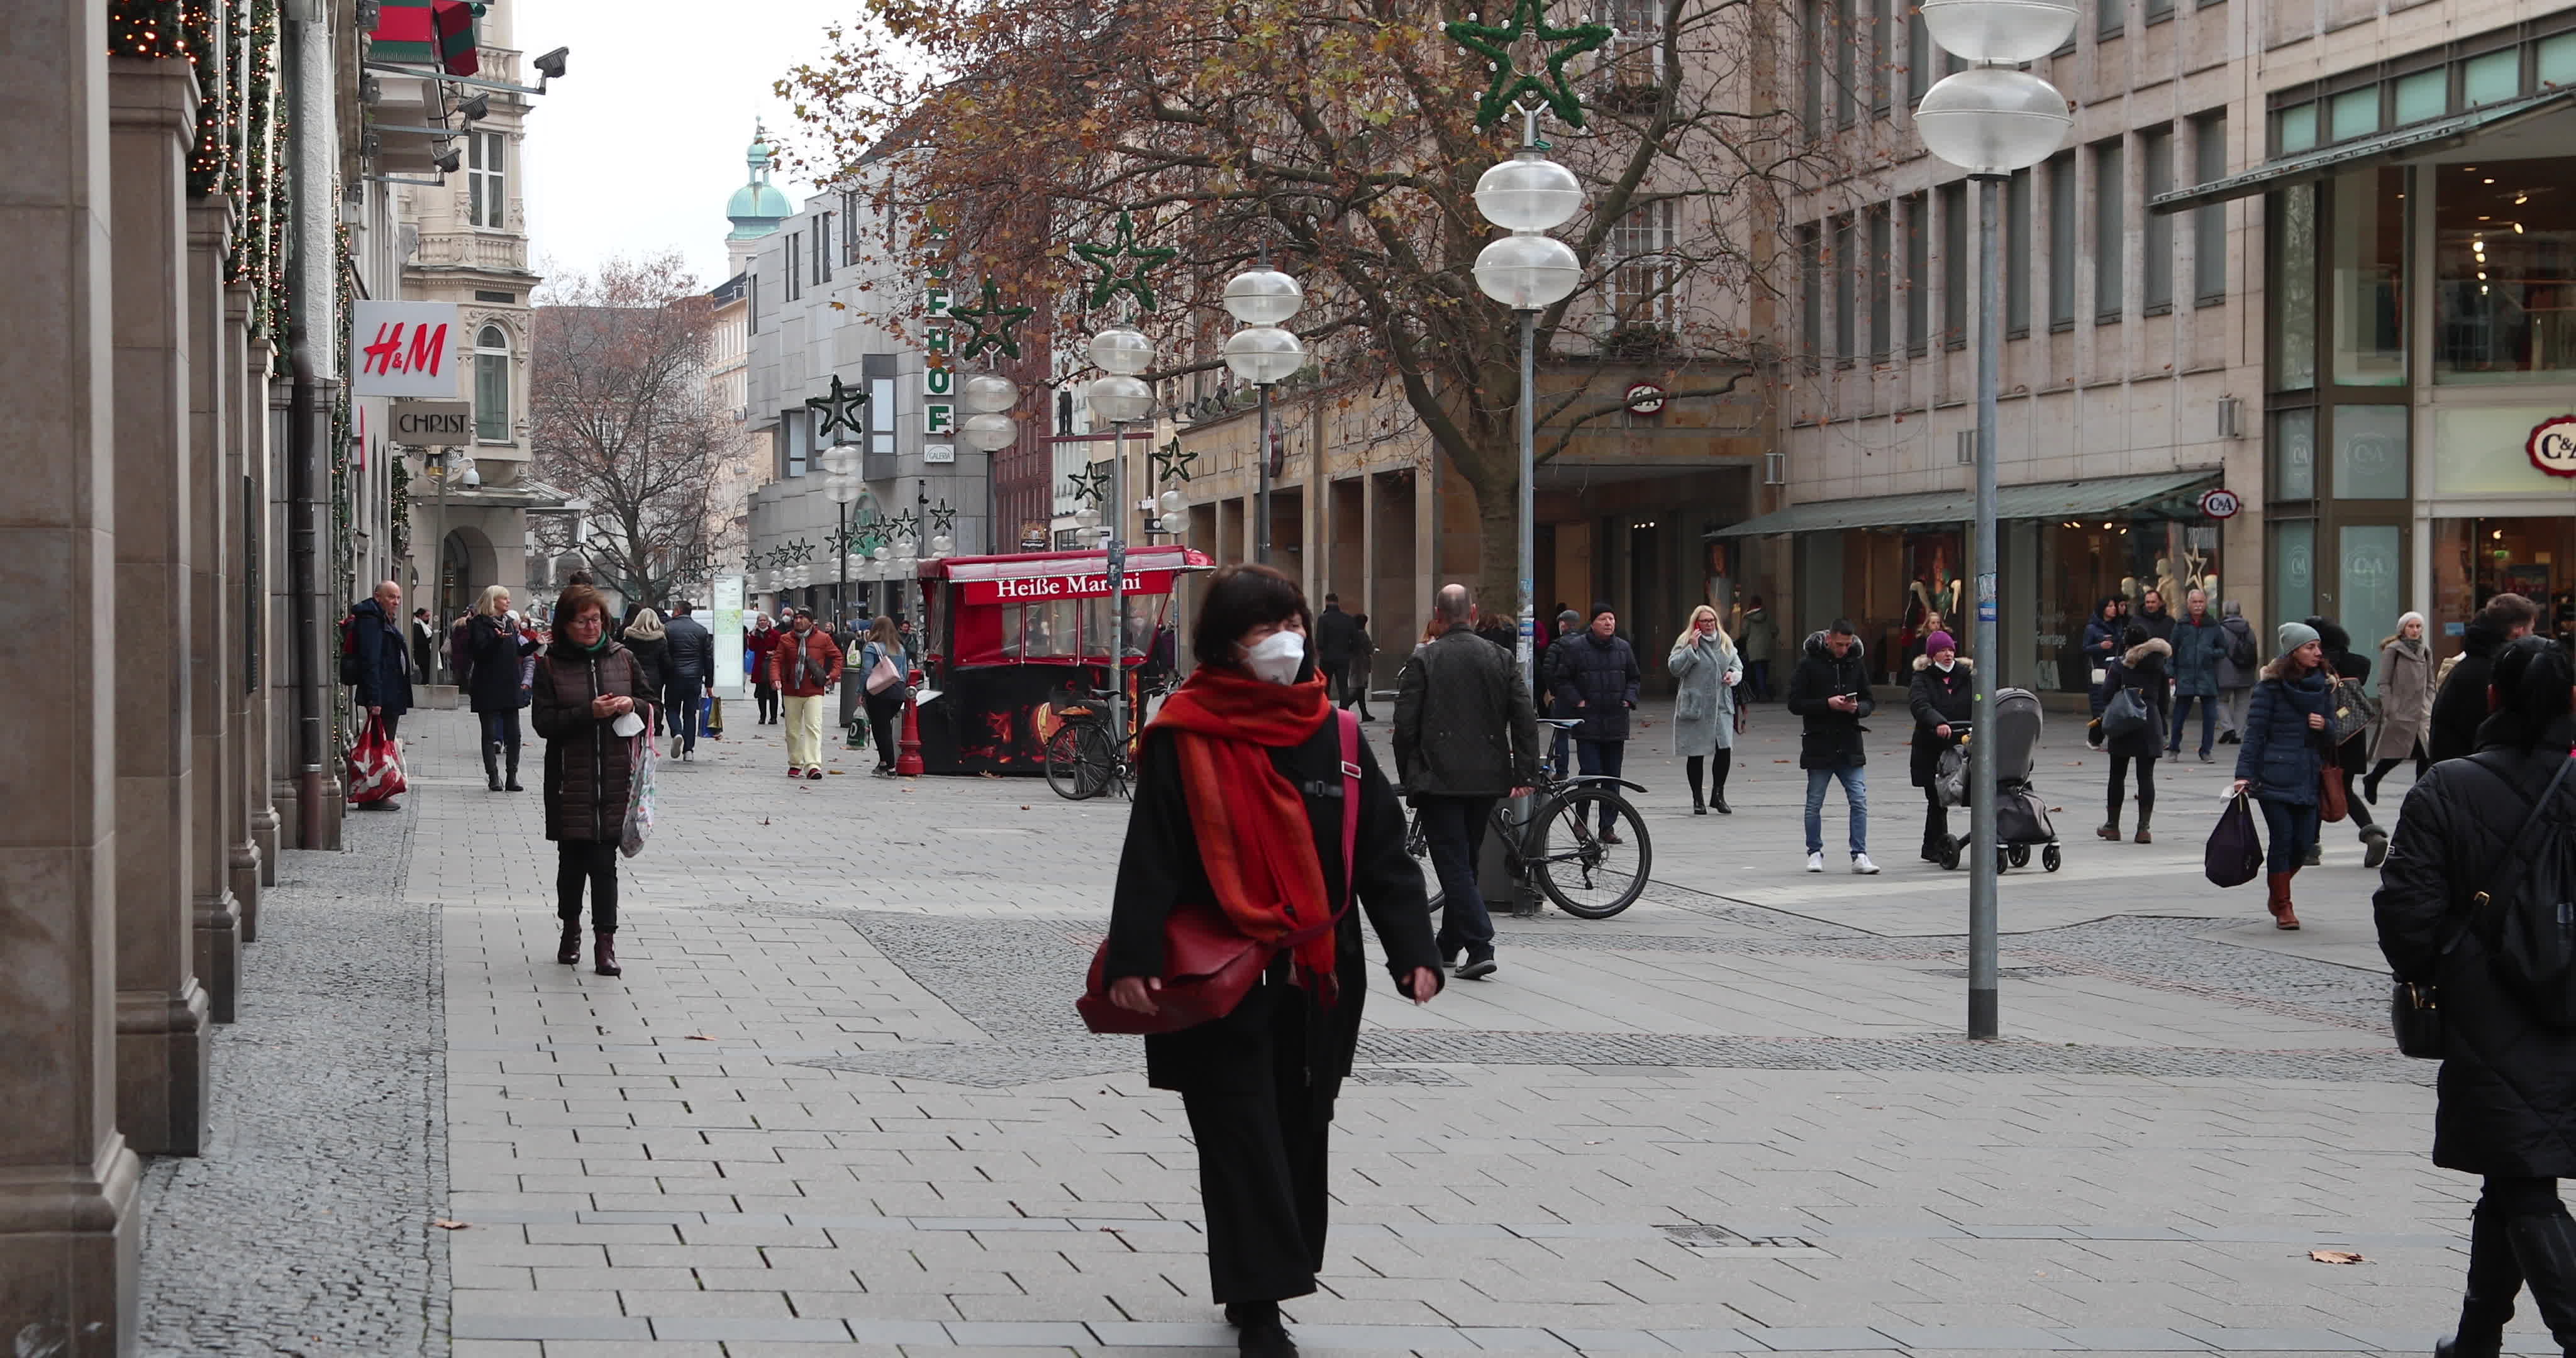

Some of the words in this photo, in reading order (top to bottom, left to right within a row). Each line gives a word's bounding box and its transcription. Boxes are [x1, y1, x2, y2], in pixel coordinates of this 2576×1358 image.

[364, 322, 447, 377] H&M
[399, 414, 467, 433] CHRIST
[2209, 497, 2233, 511] C&A
[997, 577, 1060, 597] Heiße
[1066, 572, 1142, 593] Marni
